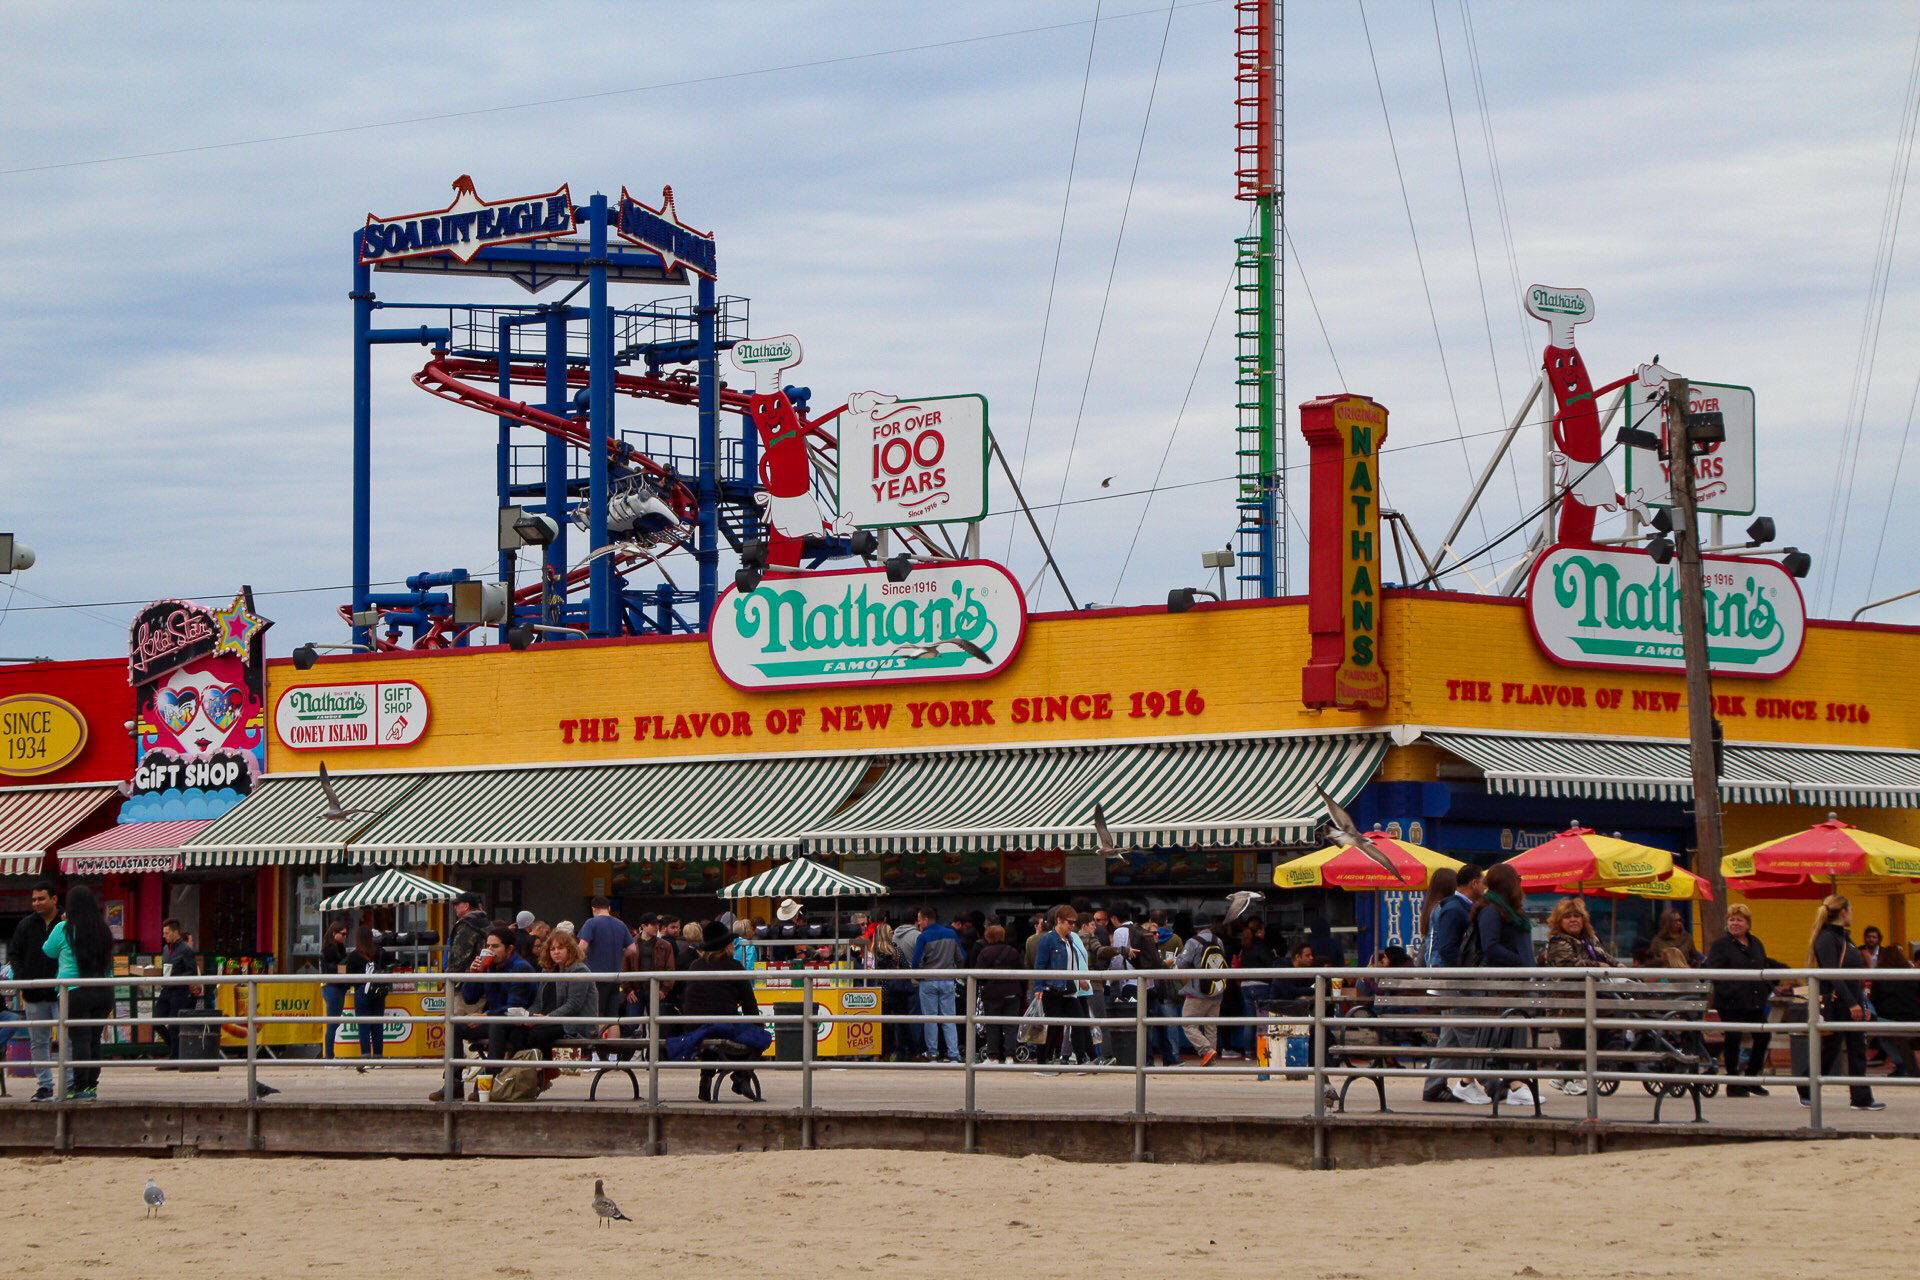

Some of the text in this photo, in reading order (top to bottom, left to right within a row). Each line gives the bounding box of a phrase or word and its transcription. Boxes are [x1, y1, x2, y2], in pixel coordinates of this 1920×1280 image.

[476, 194, 570, 240] EAGLE
[1533, 289, 1586, 310] Nathan's
[738, 342, 792, 359] Nathan's
[873, 411, 942, 440] FOR OVER
[872, 429, 945, 478] 100
[1660, 457, 1724, 483] YRS
[872, 467, 946, 502] YEARS
[908, 501, 937, 518] Since 1916
[882, 580, 937, 596] Since 1916
[1714, 573, 1734, 586] 1916
[734, 579, 997, 653] Nathan's
[167, 609, 214, 646] Star
[1634, 644, 1685, 658] FAMO
[823, 657, 908, 672] FAMOUS
[290, 691, 367, 714] Nathan's
[384, 687, 411, 701] GIFT
[1447, 679, 1492, 702] THE
[1502, 682, 1587, 707] FLAVOR
[1595, 688, 1623, 709] OF
[1632, 690, 1681, 712] NEW
[1756, 698, 1817, 720] SINCE
[1826, 702, 1870, 724] 1916
[384, 702, 412, 714] SHOP
[560, 688, 1205, 744] THE FLAVOR OF NEW YORK SINCE 1916
[3, 711, 51, 735] SINCE
[290, 723, 367, 743] CONEY ISLAND
[8, 736, 46, 759] 1934
[185, 762, 239, 785] SHOP
[77, 857, 172, 870] WWW.LOLASTAR.COM
[274, 999, 310, 1010] ENJOY
[845, 993, 874, 1004] Nathan's
[426, 1026, 445, 1040] 10
[847, 1022, 873, 1039] 100
[847, 1035, 874, 1048] YEARS
